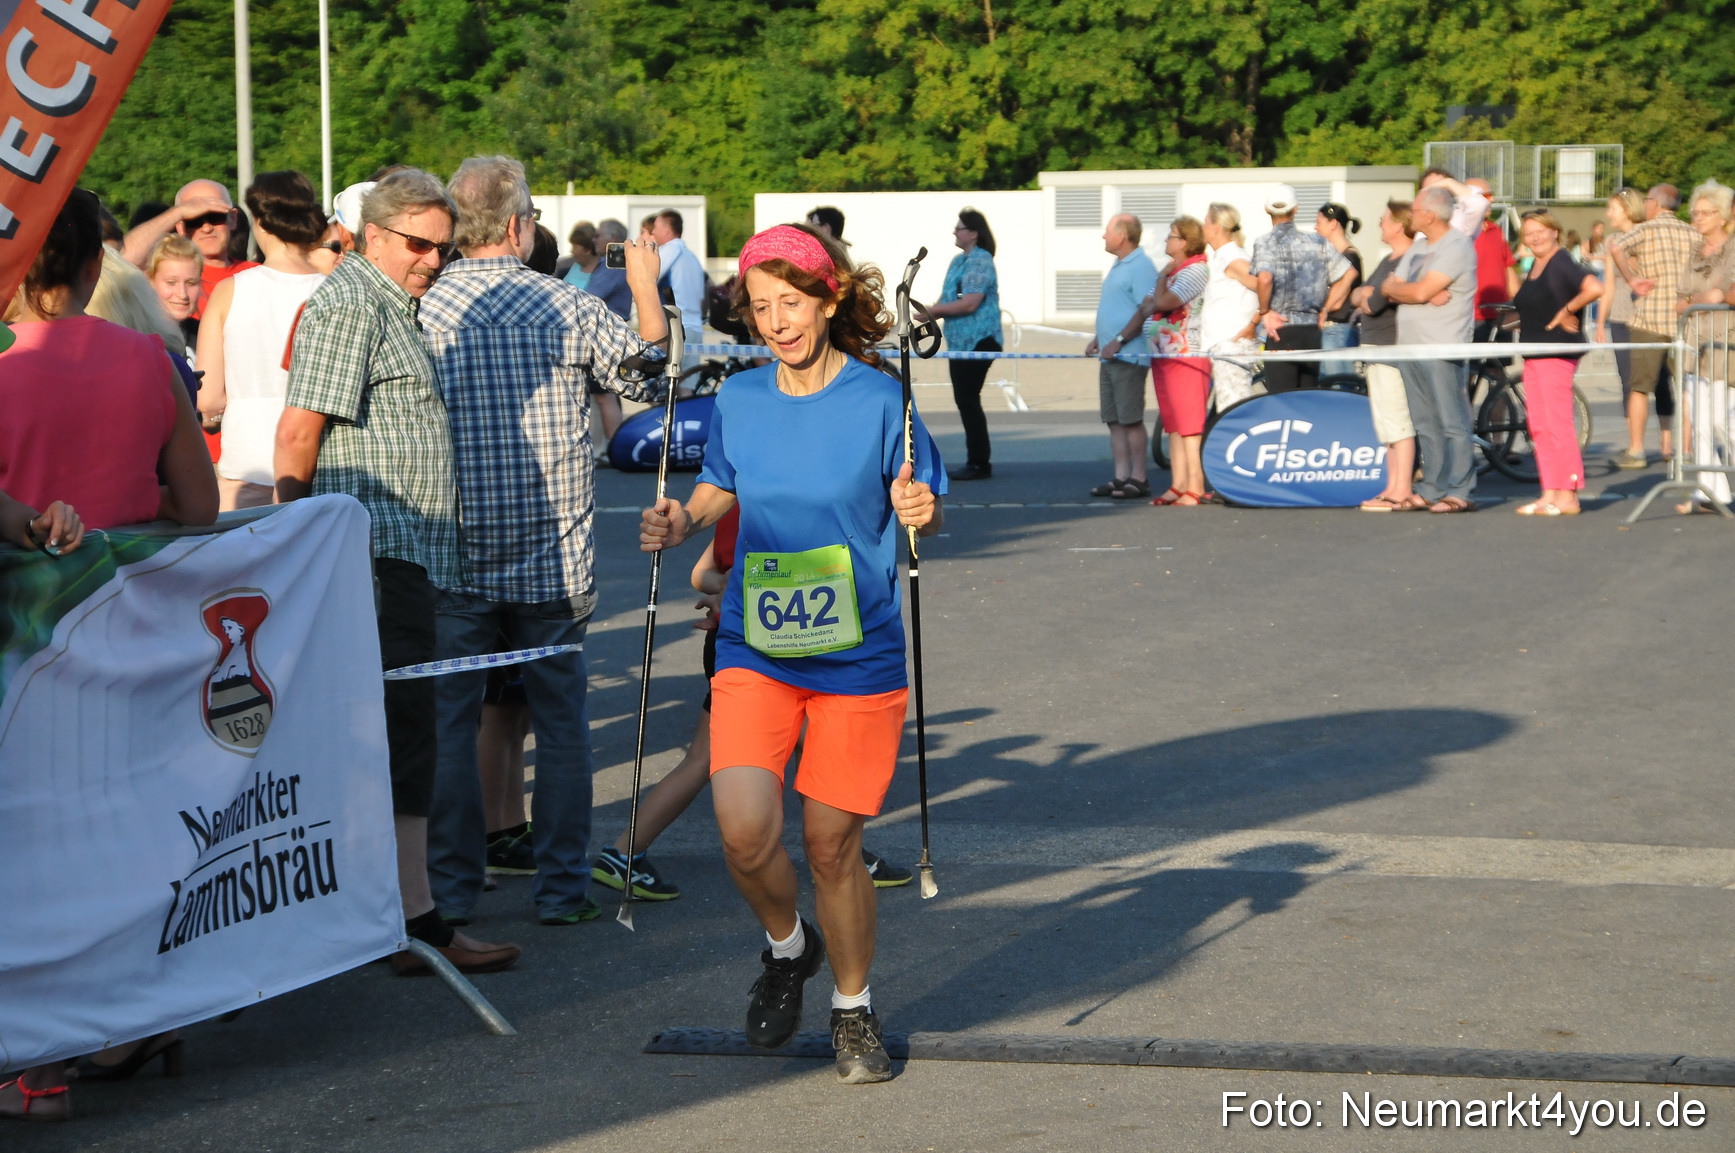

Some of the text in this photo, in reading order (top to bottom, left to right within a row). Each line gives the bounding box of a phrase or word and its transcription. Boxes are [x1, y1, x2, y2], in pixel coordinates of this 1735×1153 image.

[1256, 441, 1387, 469] Fischer
[1269, 469, 1381, 483] AUTOMOBILE
[758, 586, 838, 631] 642
[793, 629, 834, 640] Schickedanz
[799, 639, 827, 648] Neumarkt
[224, 712, 265, 742] 1628
[157, 825, 339, 956] Lammsbräu
